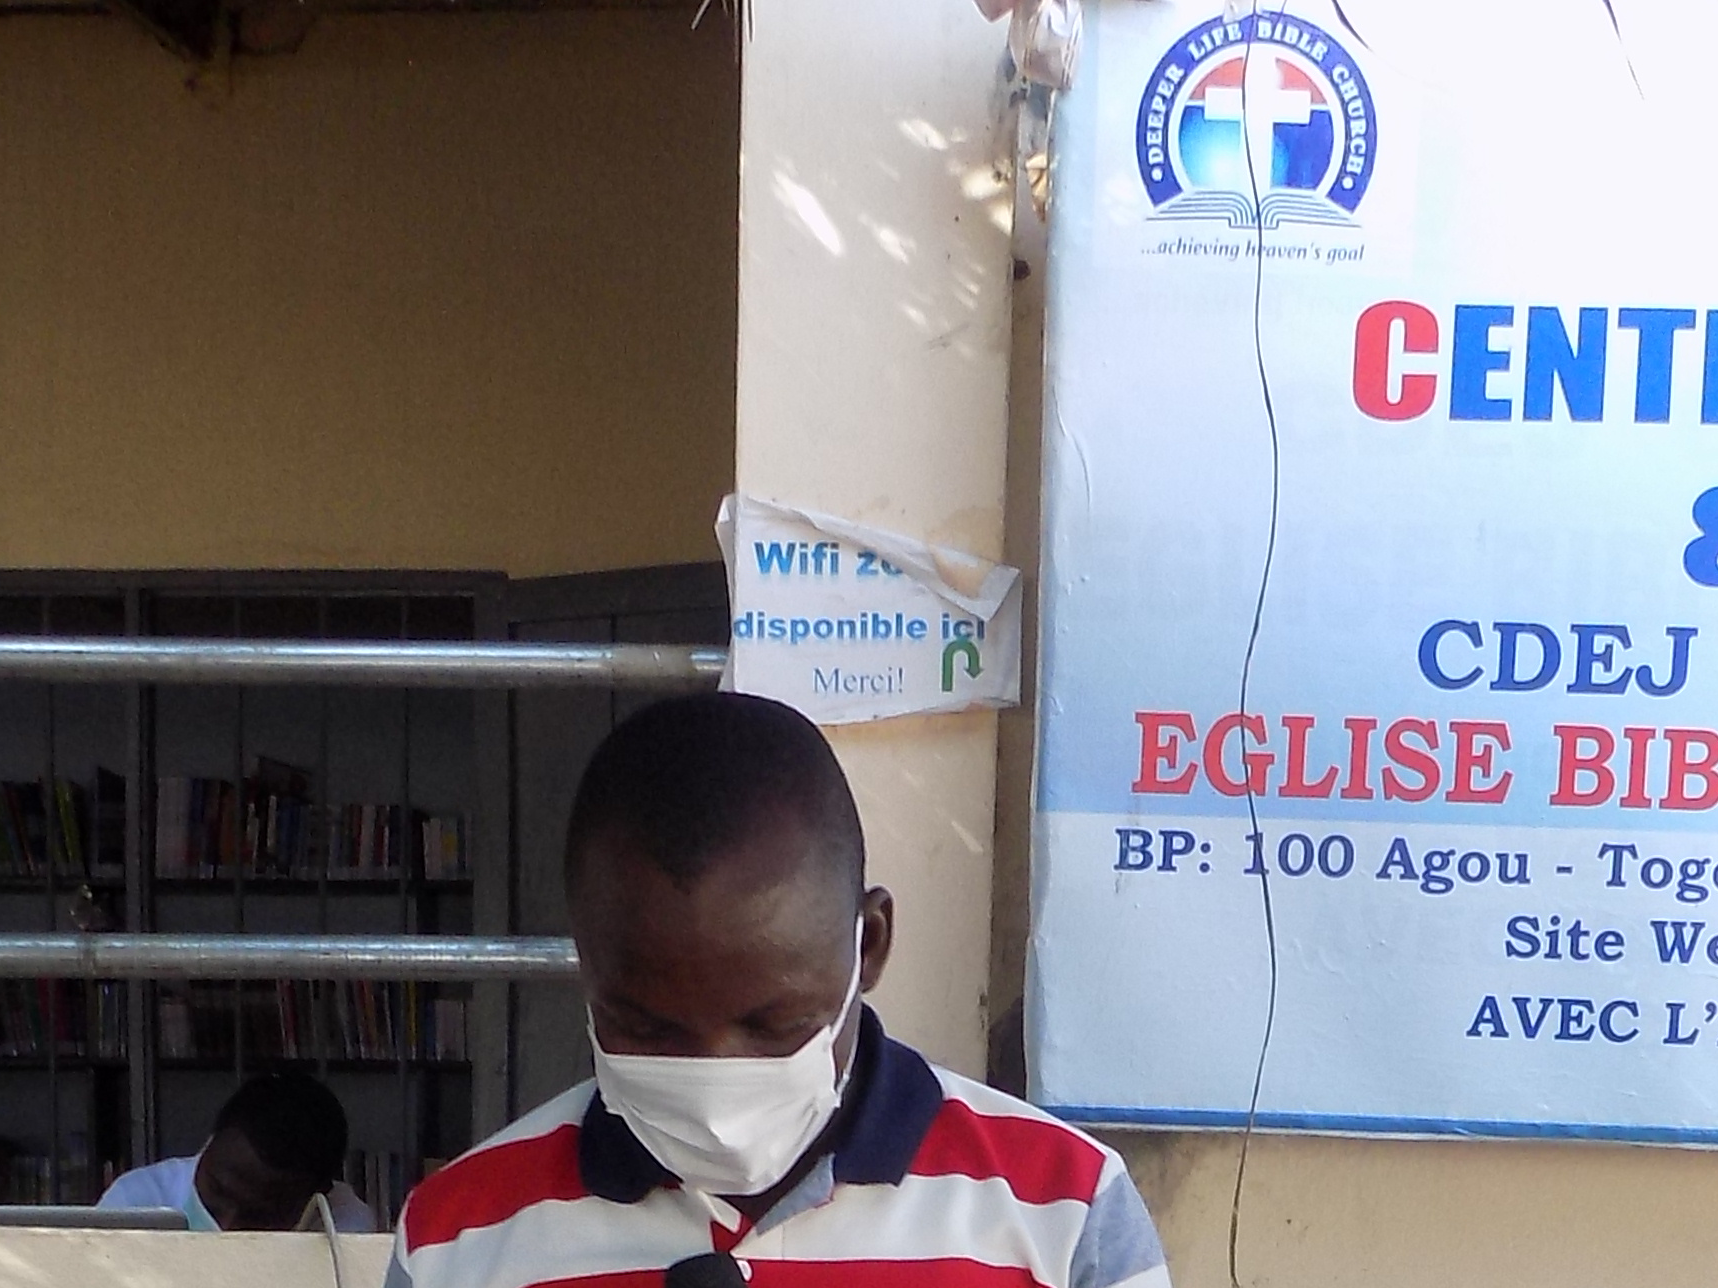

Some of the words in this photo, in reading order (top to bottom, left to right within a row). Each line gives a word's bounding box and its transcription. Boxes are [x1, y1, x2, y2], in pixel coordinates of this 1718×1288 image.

[1146, 63, 1186, 166] DEEPER
[1185, 21, 1243, 62] LIFE
[1256, 18, 1332, 62] BIBLE
[1330, 63, 1368, 176] CHURCH
[1325, 243, 1366, 266] goal
[753, 541, 841, 577] Wifi
[733, 611, 930, 646] disponible
[813, 667, 906, 694] Merci!
[1417, 619, 1699, 698] CDEJ
[1130, 710, 1515, 806] EGLISE
[1112, 828, 1214, 875] BP:
[1243, 832, 1355, 878] 100
[1375, 836, 1532, 895] Agou
[1504, 916, 1626, 963] Site
[1465, 994, 1641, 1044] AVEC
